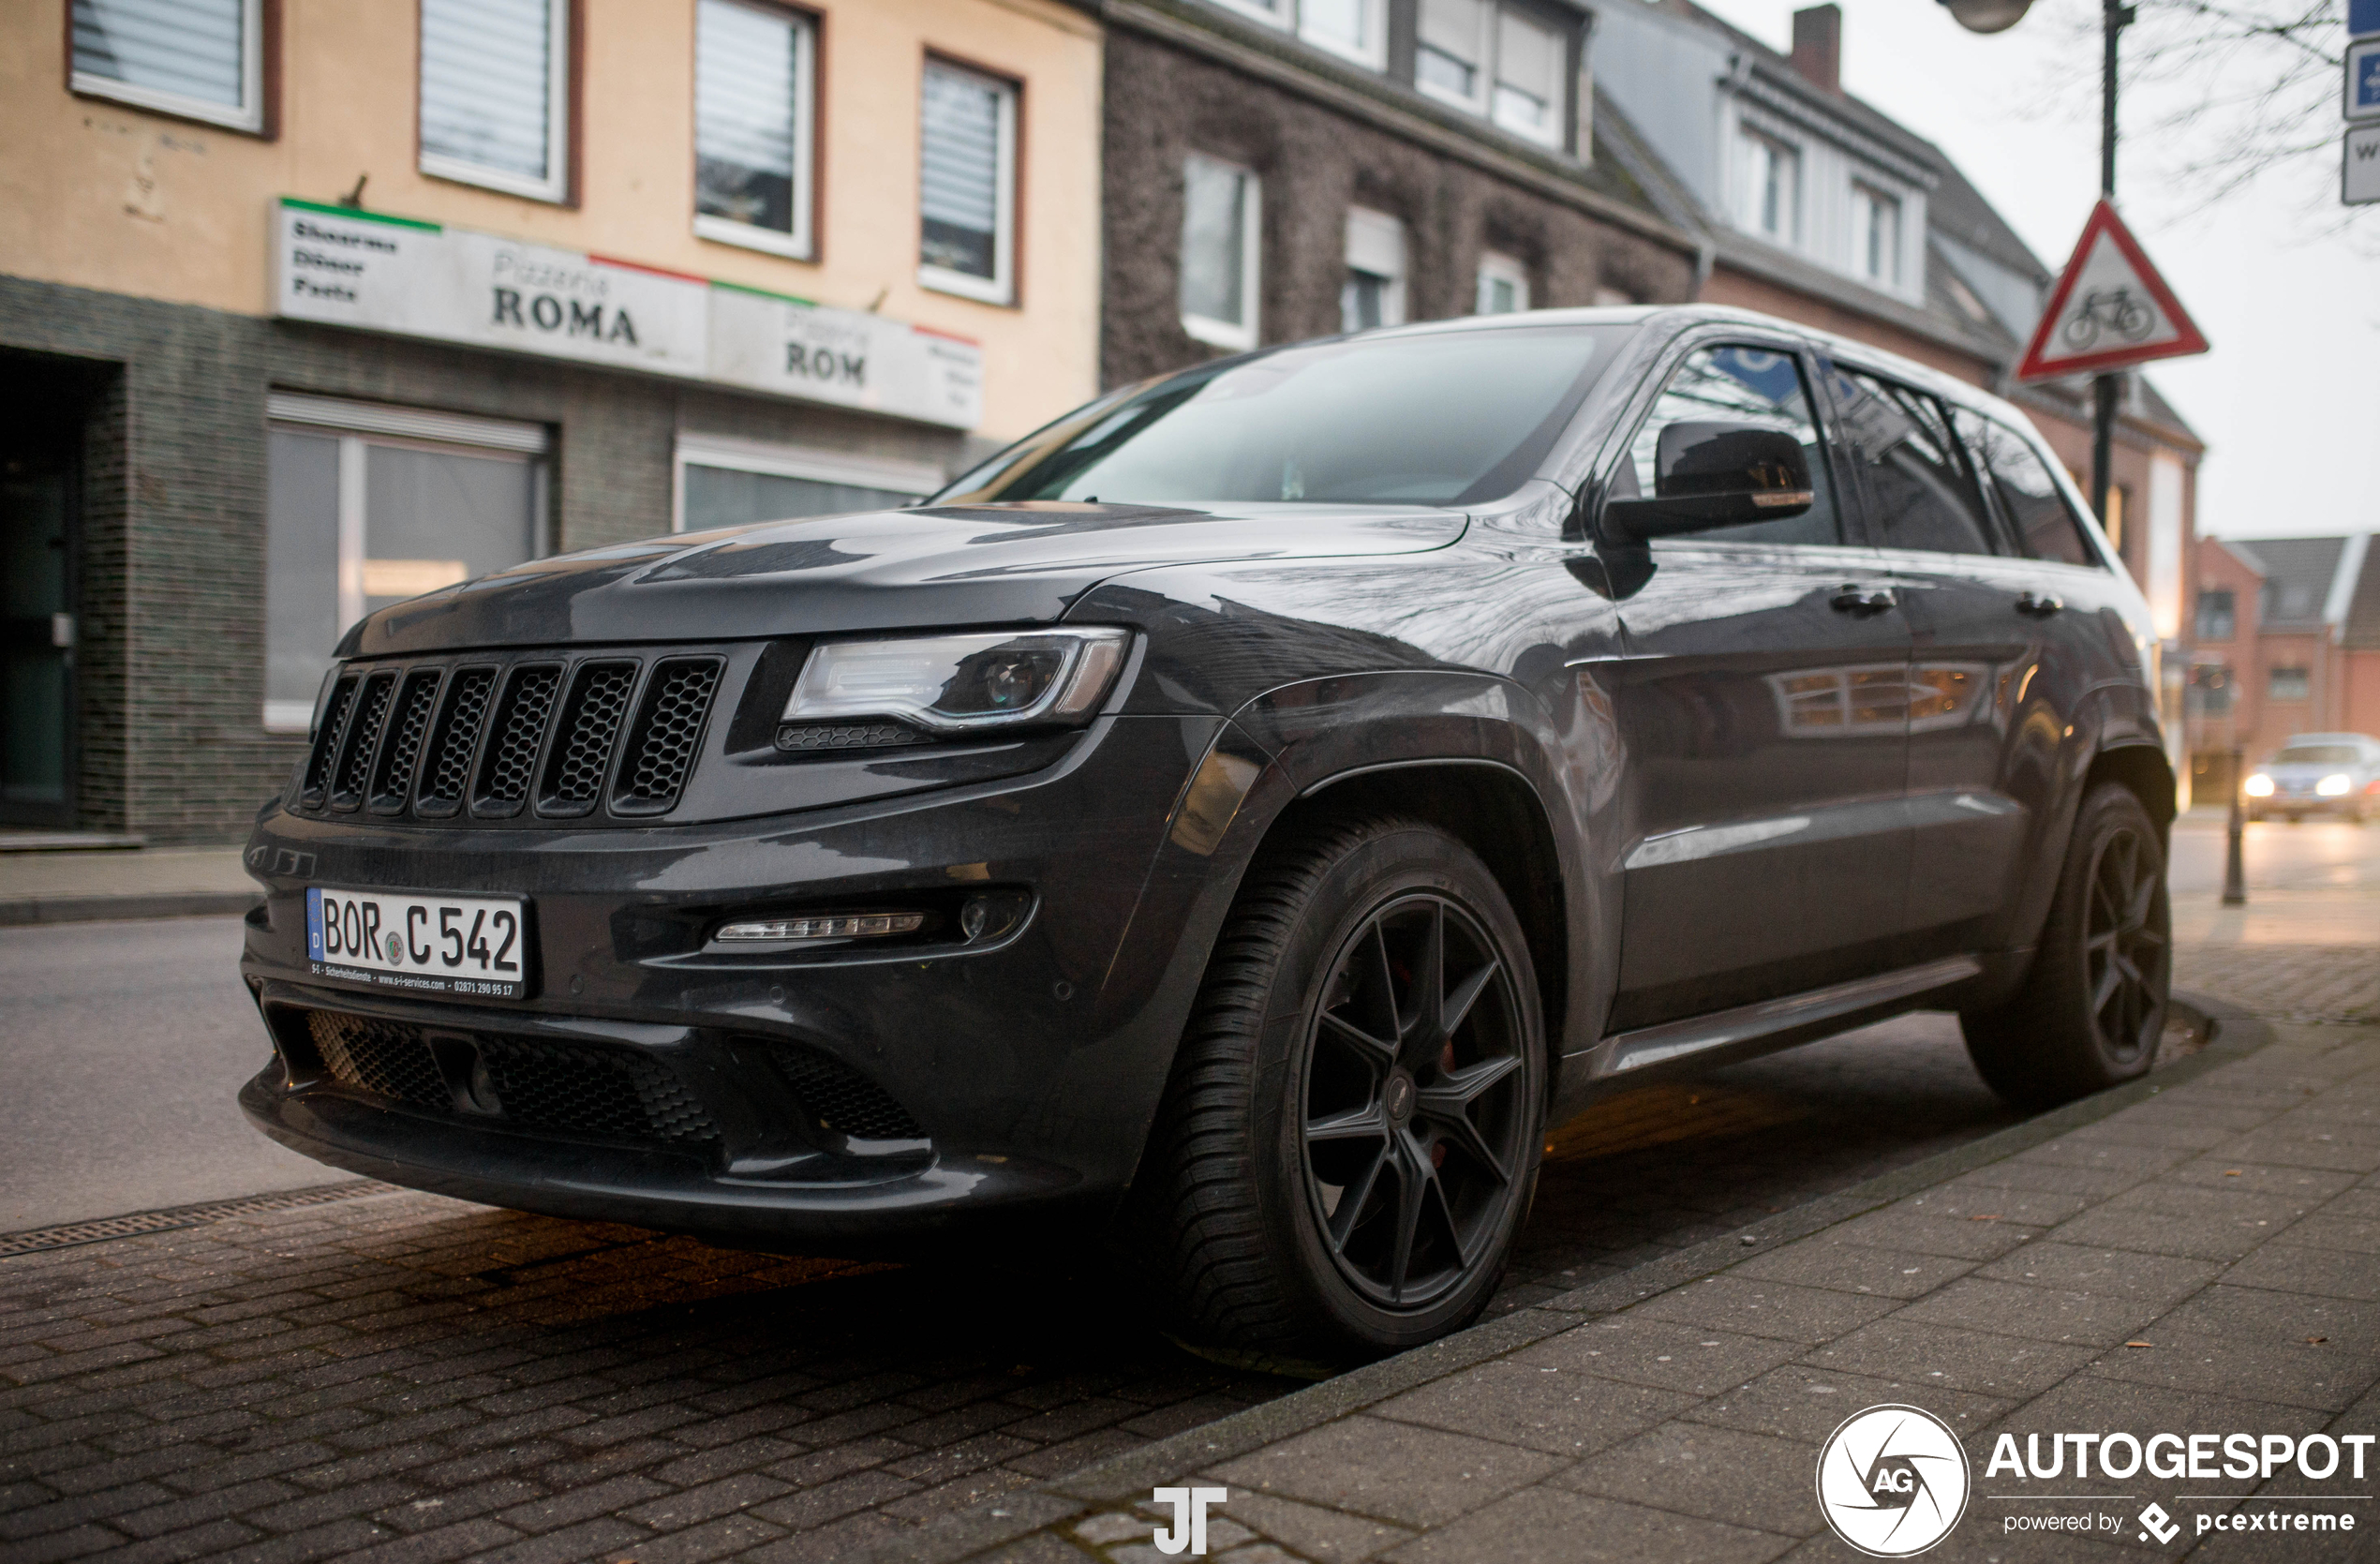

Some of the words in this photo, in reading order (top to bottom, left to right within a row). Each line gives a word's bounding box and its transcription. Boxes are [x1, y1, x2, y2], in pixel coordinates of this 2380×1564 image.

[293, 278, 356, 303] Pasta
[492, 285, 639, 347] ROMA
[312, 932, 320, 948] D
[323, 898, 384, 961] BOR
[407, 905, 431, 965] C
[439, 906, 518, 972] 542
[454, 980, 476, 993] 02871
[477, 982, 491, 994] 290
[492, 984, 502, 995] 95
[503, 985, 513, 996] 17
